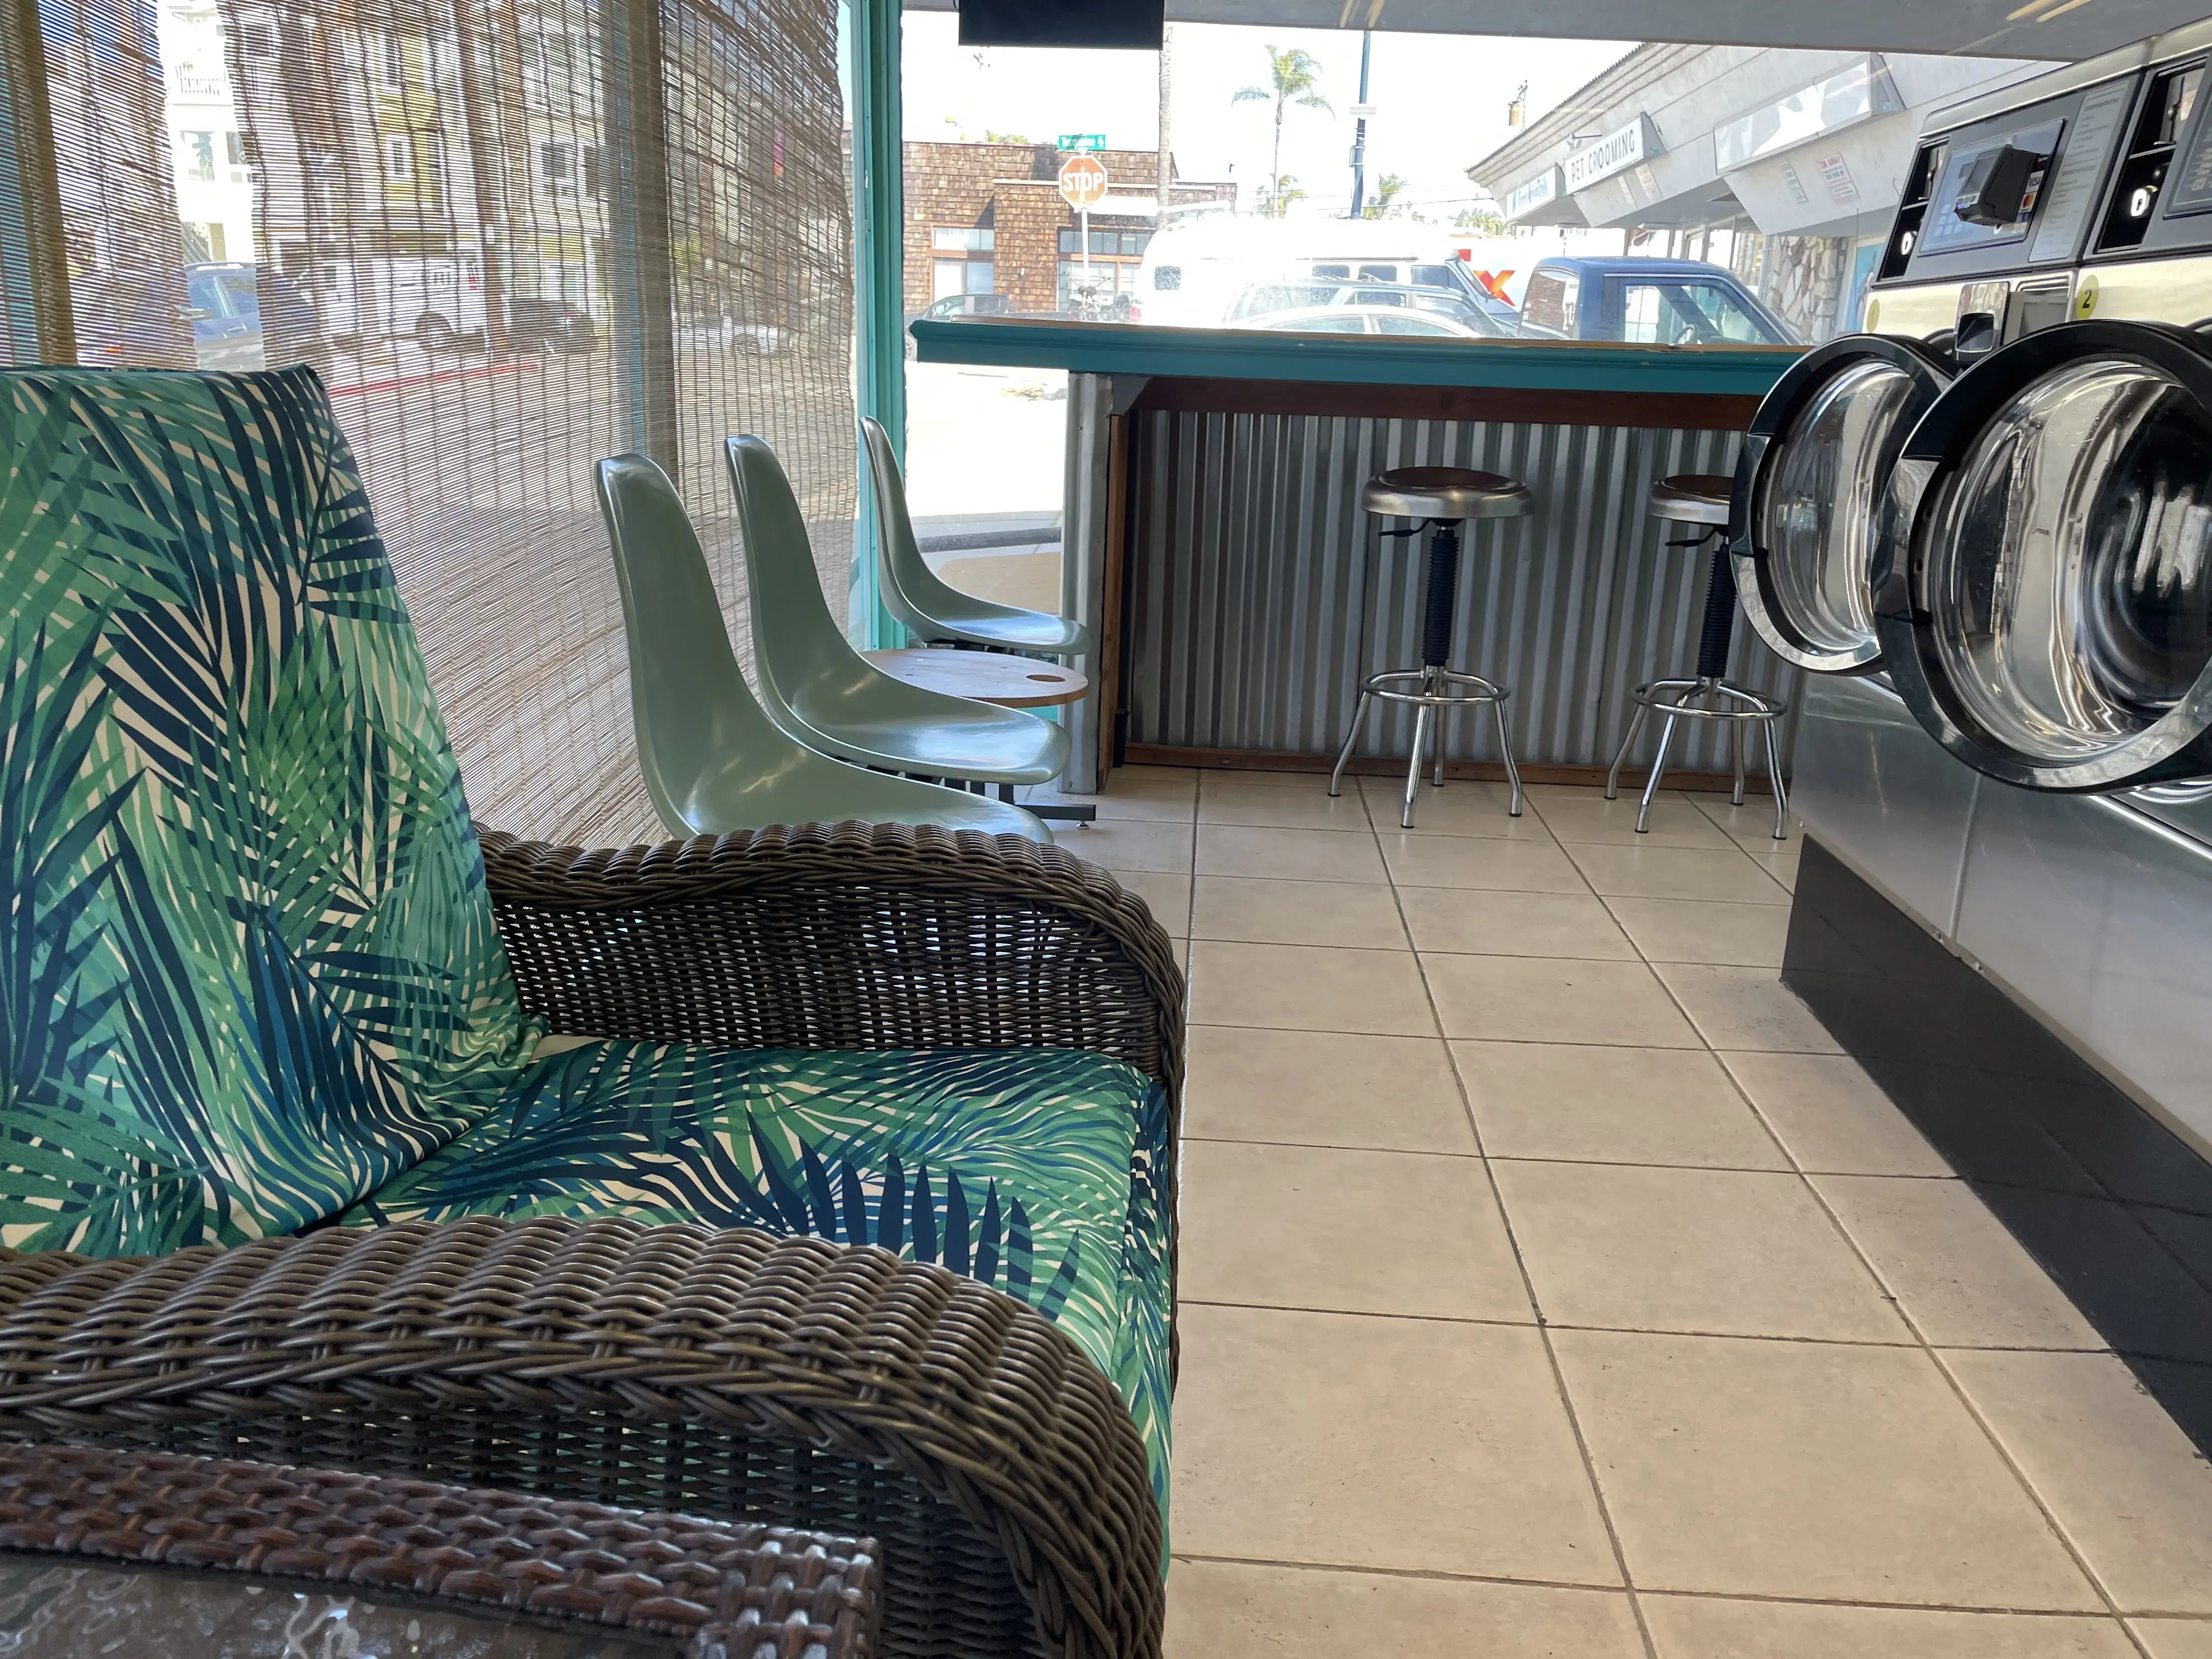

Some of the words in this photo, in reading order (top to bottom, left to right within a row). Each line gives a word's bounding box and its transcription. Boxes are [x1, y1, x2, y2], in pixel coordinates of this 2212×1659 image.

[1571, 157, 1584, 183] PET
[1588, 129, 1635, 175] GROOMING
[1063, 172, 1104, 192] STOP
[2082, 288, 2092, 309] 2
